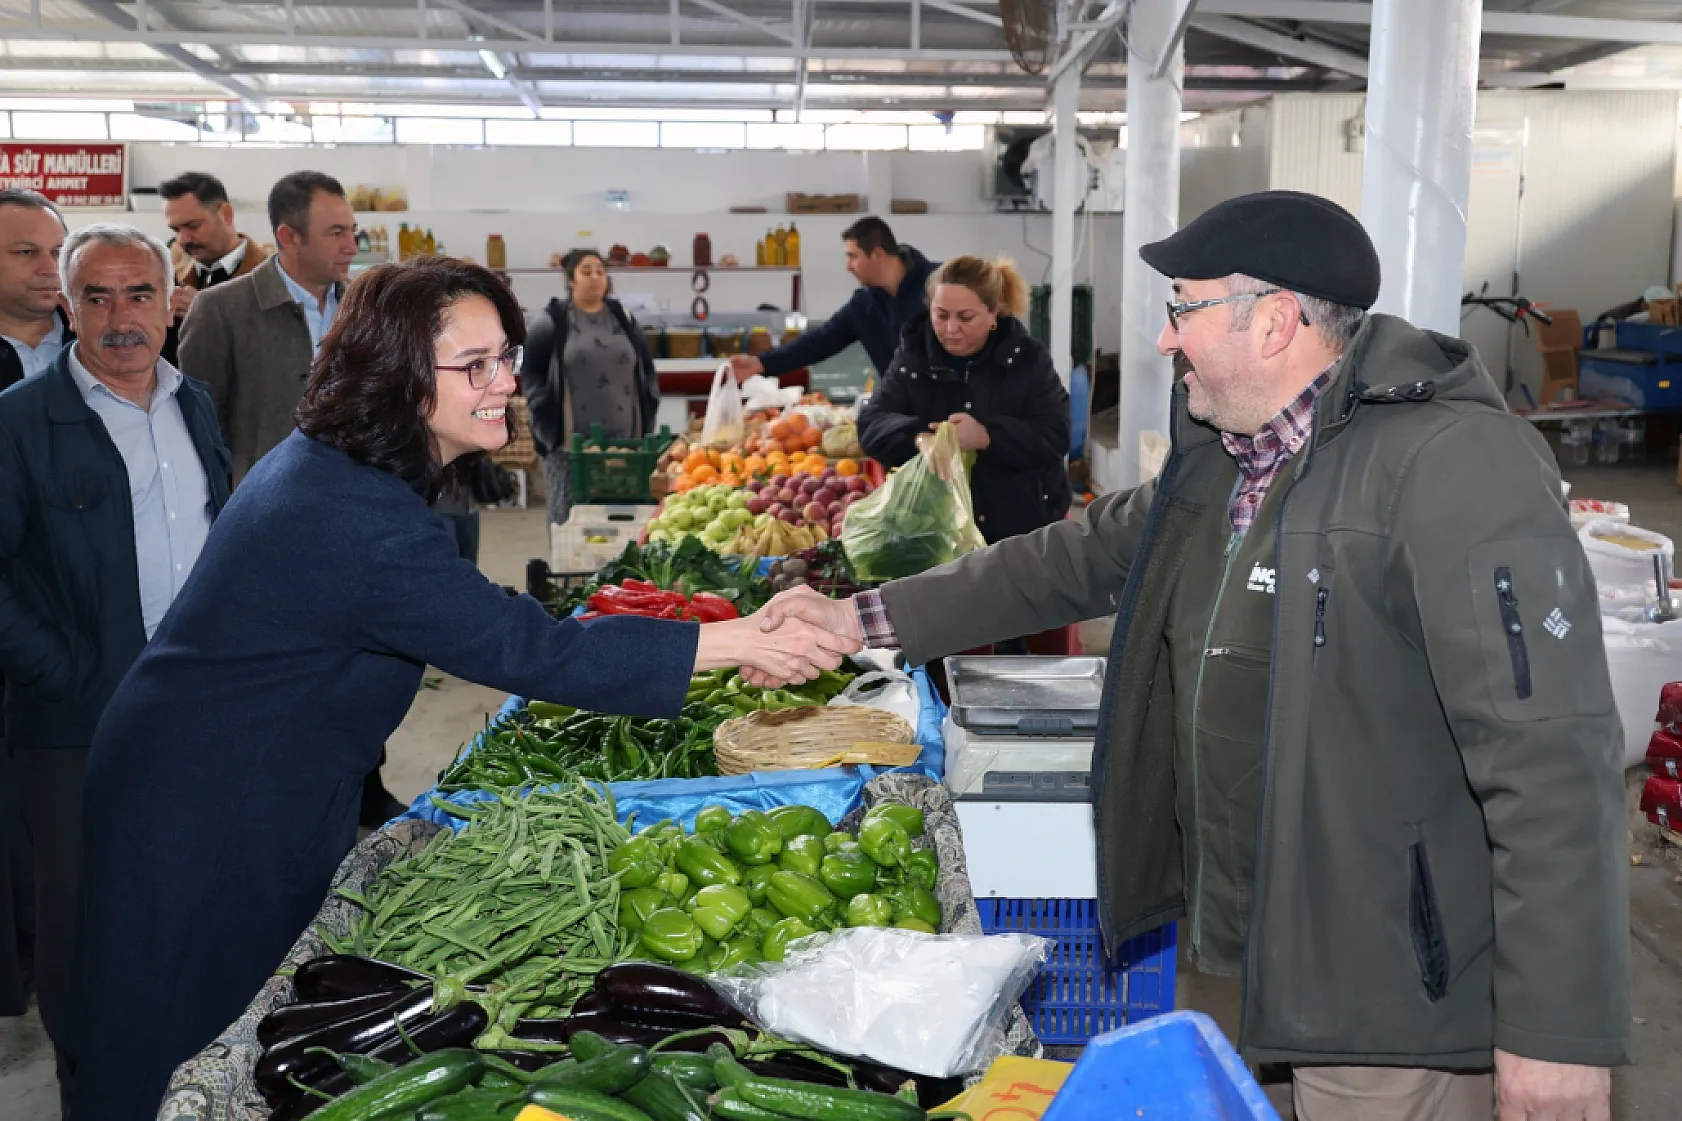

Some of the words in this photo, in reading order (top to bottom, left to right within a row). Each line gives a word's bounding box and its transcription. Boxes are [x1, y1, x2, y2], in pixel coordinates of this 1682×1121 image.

[13, 149, 41, 174] SÜT
[43, 149, 122, 174] MAMÜLLERİ
[46, 177, 88, 190] AHMET
